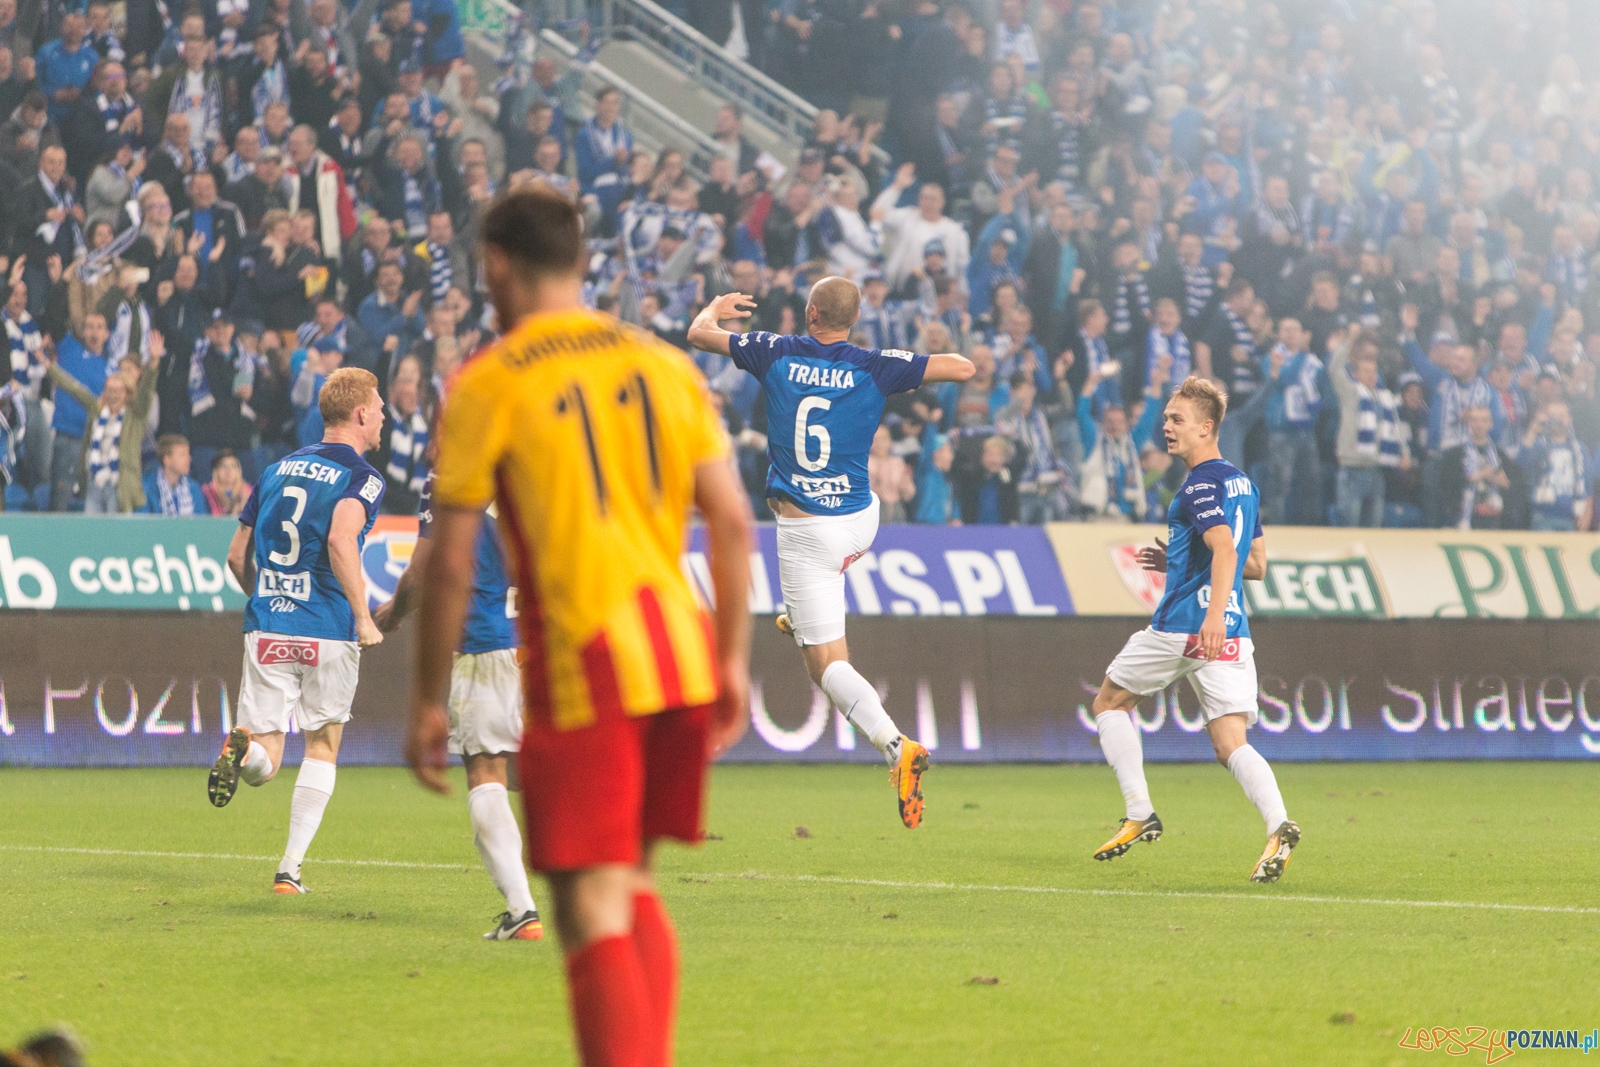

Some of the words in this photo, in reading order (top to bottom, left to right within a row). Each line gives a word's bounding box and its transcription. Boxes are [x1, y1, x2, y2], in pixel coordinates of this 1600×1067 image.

[788, 362, 855, 389] TRAŁKA
[554, 368, 664, 514] 11
[794, 396, 832, 472] 6
[276, 460, 342, 485] NIELSEN
[796, 479, 847, 495] LECH
[268, 485, 308, 567] 3
[0, 535, 58, 610] b
[262, 573, 306, 596] LECH
[1249, 563, 1377, 611] LECH
[1434, 543, 1600, 617] PIL
[269, 597, 299, 613] Pils
